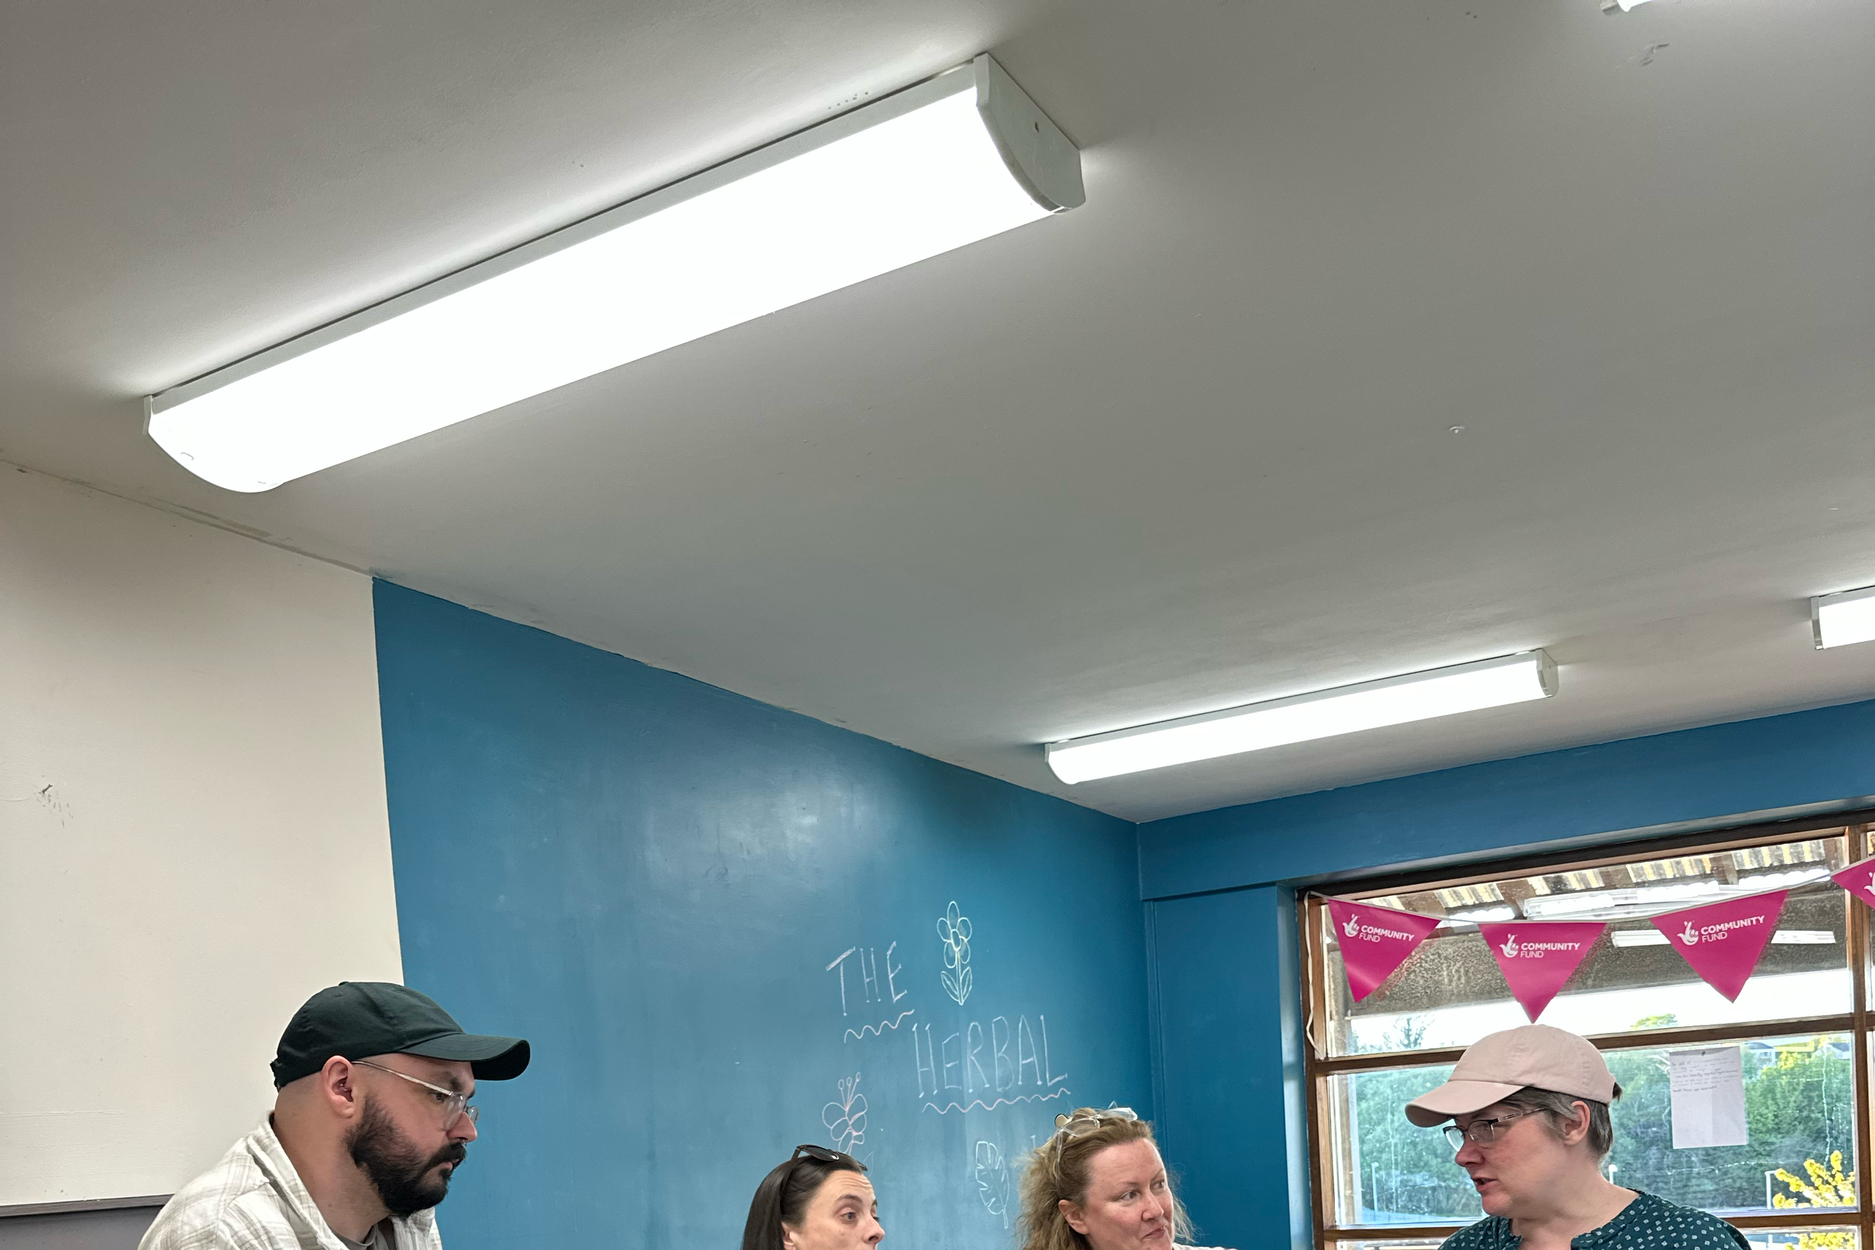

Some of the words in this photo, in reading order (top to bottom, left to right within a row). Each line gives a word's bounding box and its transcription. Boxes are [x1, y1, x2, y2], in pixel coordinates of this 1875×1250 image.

[1700, 915, 1765, 935] COMMUNITY
[1358, 932, 1380, 943] FUND
[1361, 925, 1415, 941] COMMUNITY
[1702, 931, 1728, 943] FUND
[1520, 942, 1581, 951] COMMUNITY
[1520, 950, 1544, 959] FUND
[826, 941, 907, 1016] THE
[912, 1014, 1068, 1098] HERBAL
